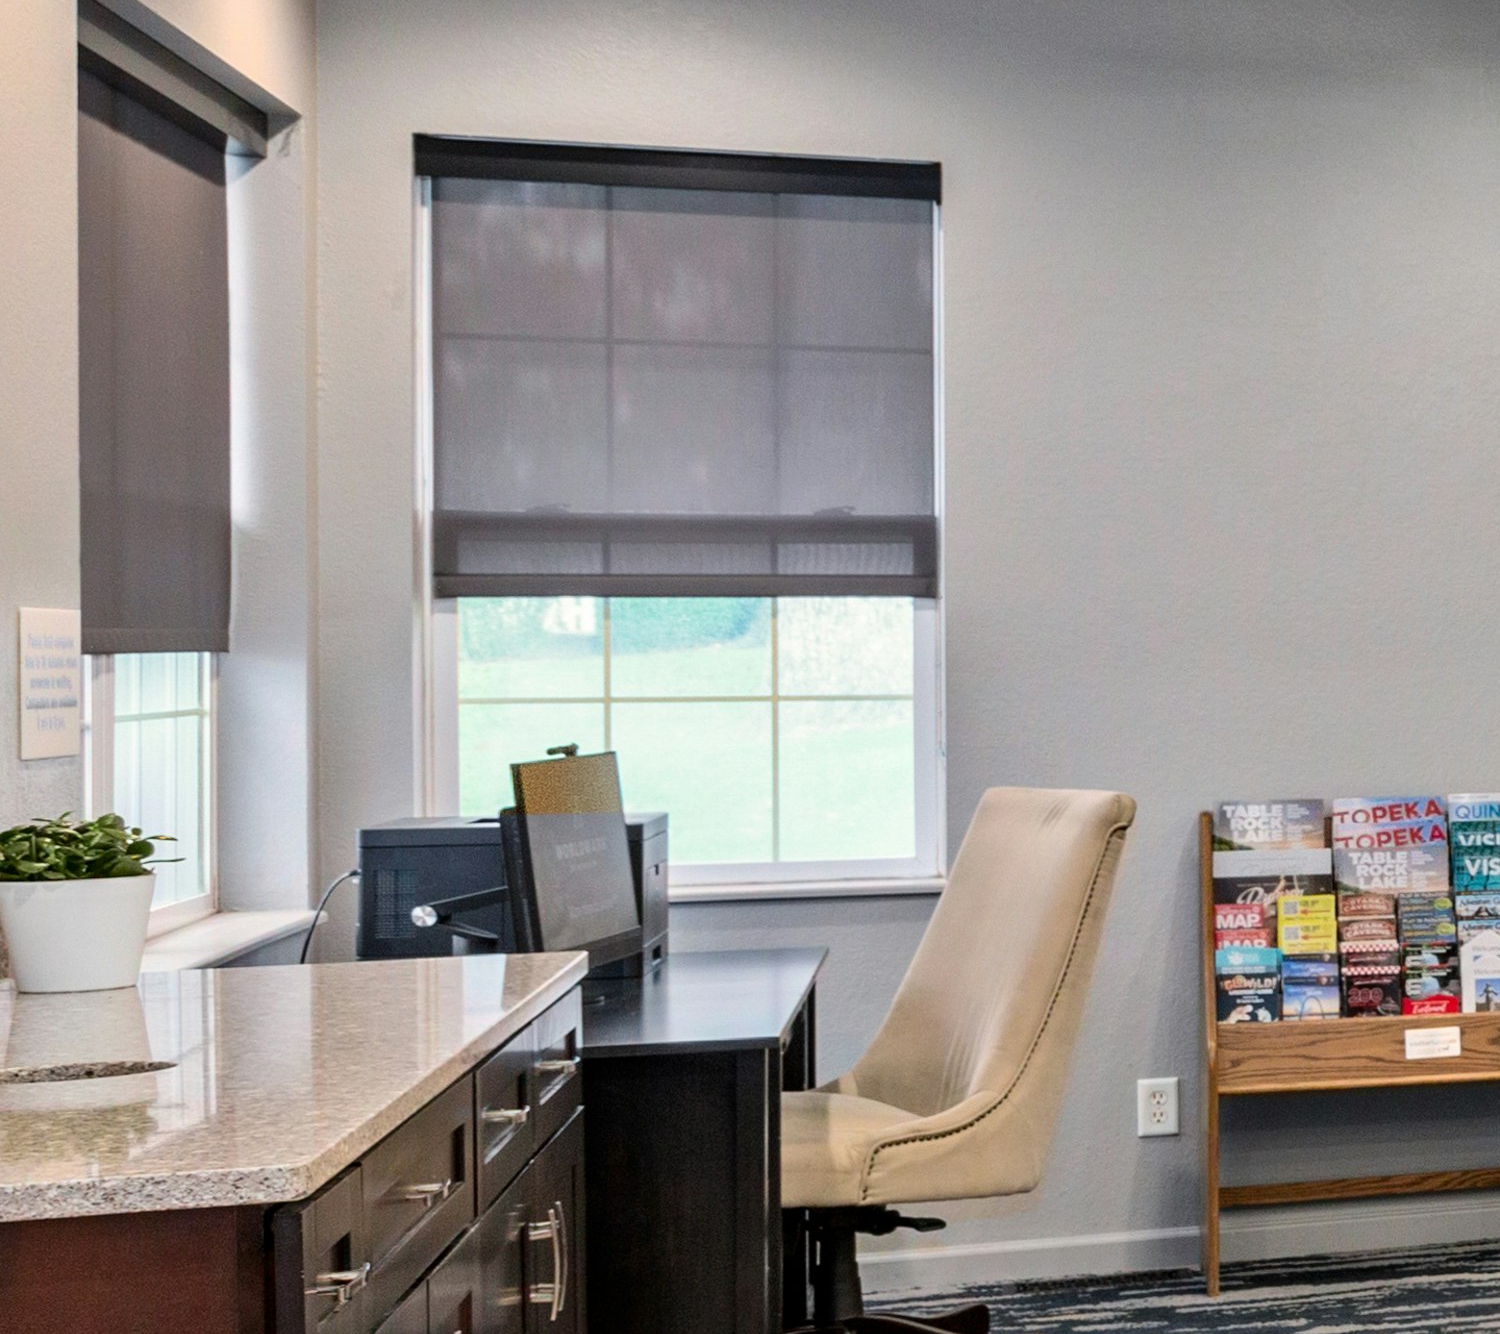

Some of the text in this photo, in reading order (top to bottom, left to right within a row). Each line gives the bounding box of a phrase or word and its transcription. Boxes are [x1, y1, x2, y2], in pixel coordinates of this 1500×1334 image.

[1222, 804, 1283, 818] TABLE
[1332, 799, 1444, 823] TOPEKA
[1230, 817, 1283, 830] ROCK
[1232, 829, 1283, 842] LAKE
[1334, 824, 1446, 848] TOPEKA
[1348, 851, 1408, 865] TABLE
[1356, 863, 1408, 877] ROCK
[1359, 876, 1408, 888] LAKE
[1216, 913, 1260, 929] MAP
